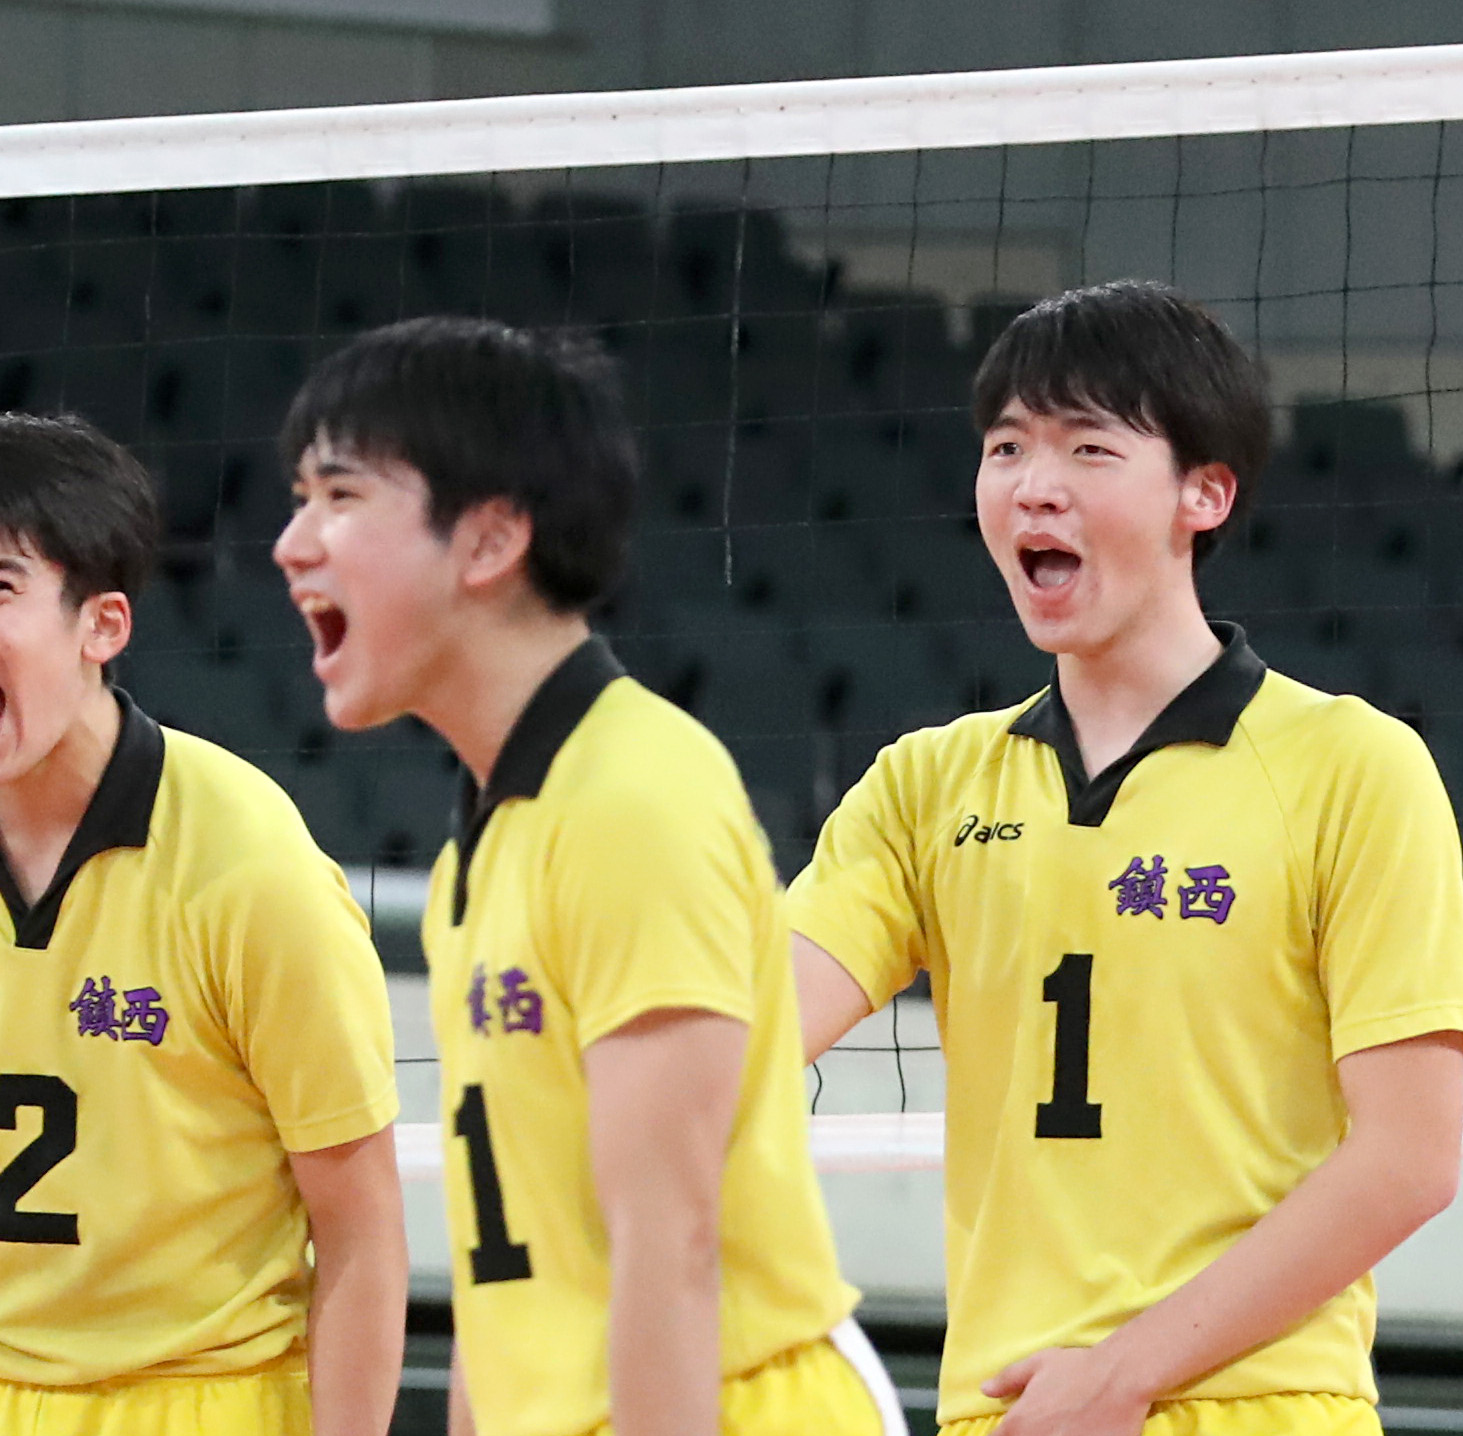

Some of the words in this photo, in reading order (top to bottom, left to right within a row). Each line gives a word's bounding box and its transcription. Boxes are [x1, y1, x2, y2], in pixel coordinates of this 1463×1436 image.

[1108, 854, 1236, 924] 鎮西
[70, 975, 169, 1046] 鎮西
[1035, 953, 1102, 1139] 1
